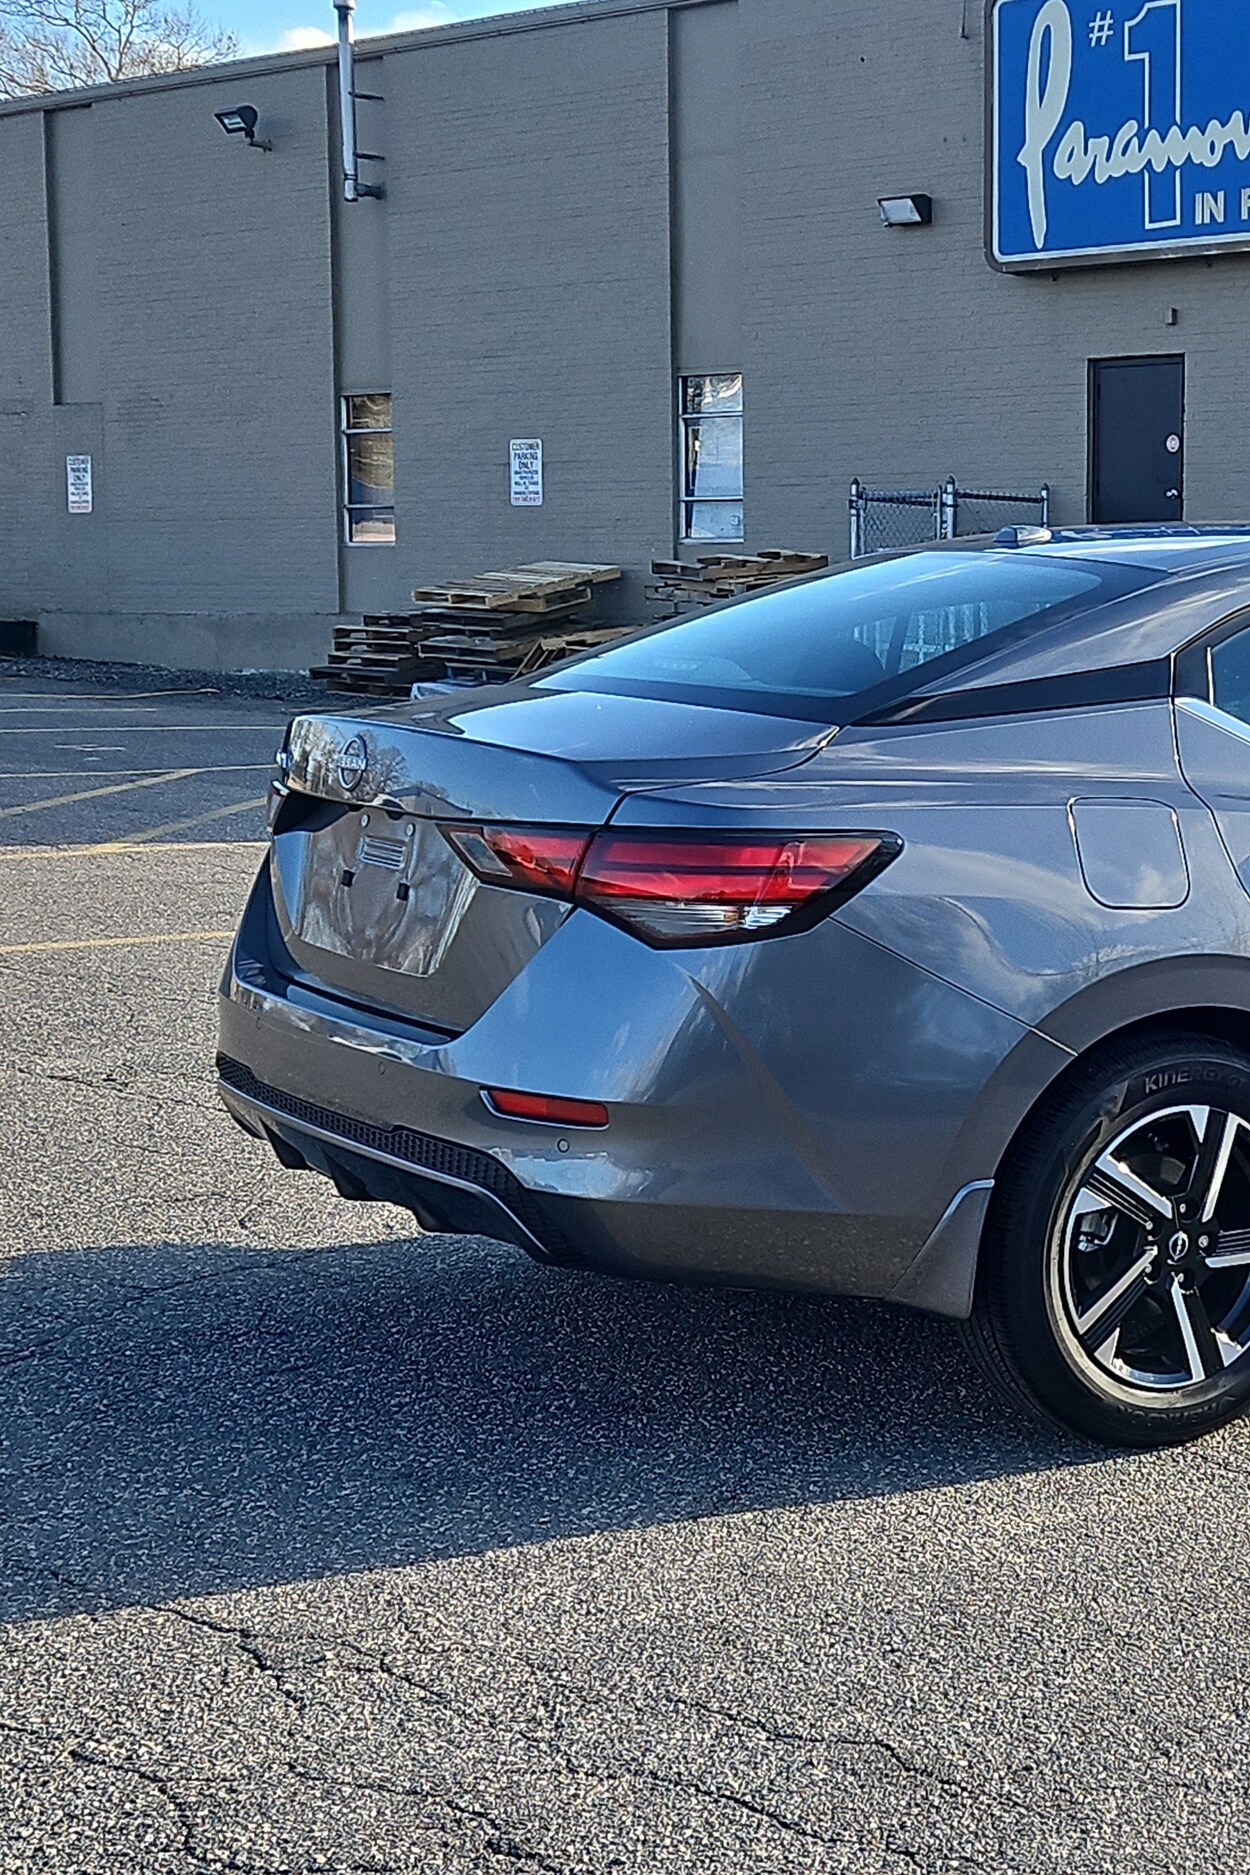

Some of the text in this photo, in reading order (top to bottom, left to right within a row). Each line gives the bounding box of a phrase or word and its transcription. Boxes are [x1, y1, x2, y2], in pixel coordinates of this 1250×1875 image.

[1195, 190, 1225, 225] IN
[512, 443, 540, 451] CUSTOMER
[513, 452, 539, 461] PARKING
[518, 461, 534, 470] ONLY
